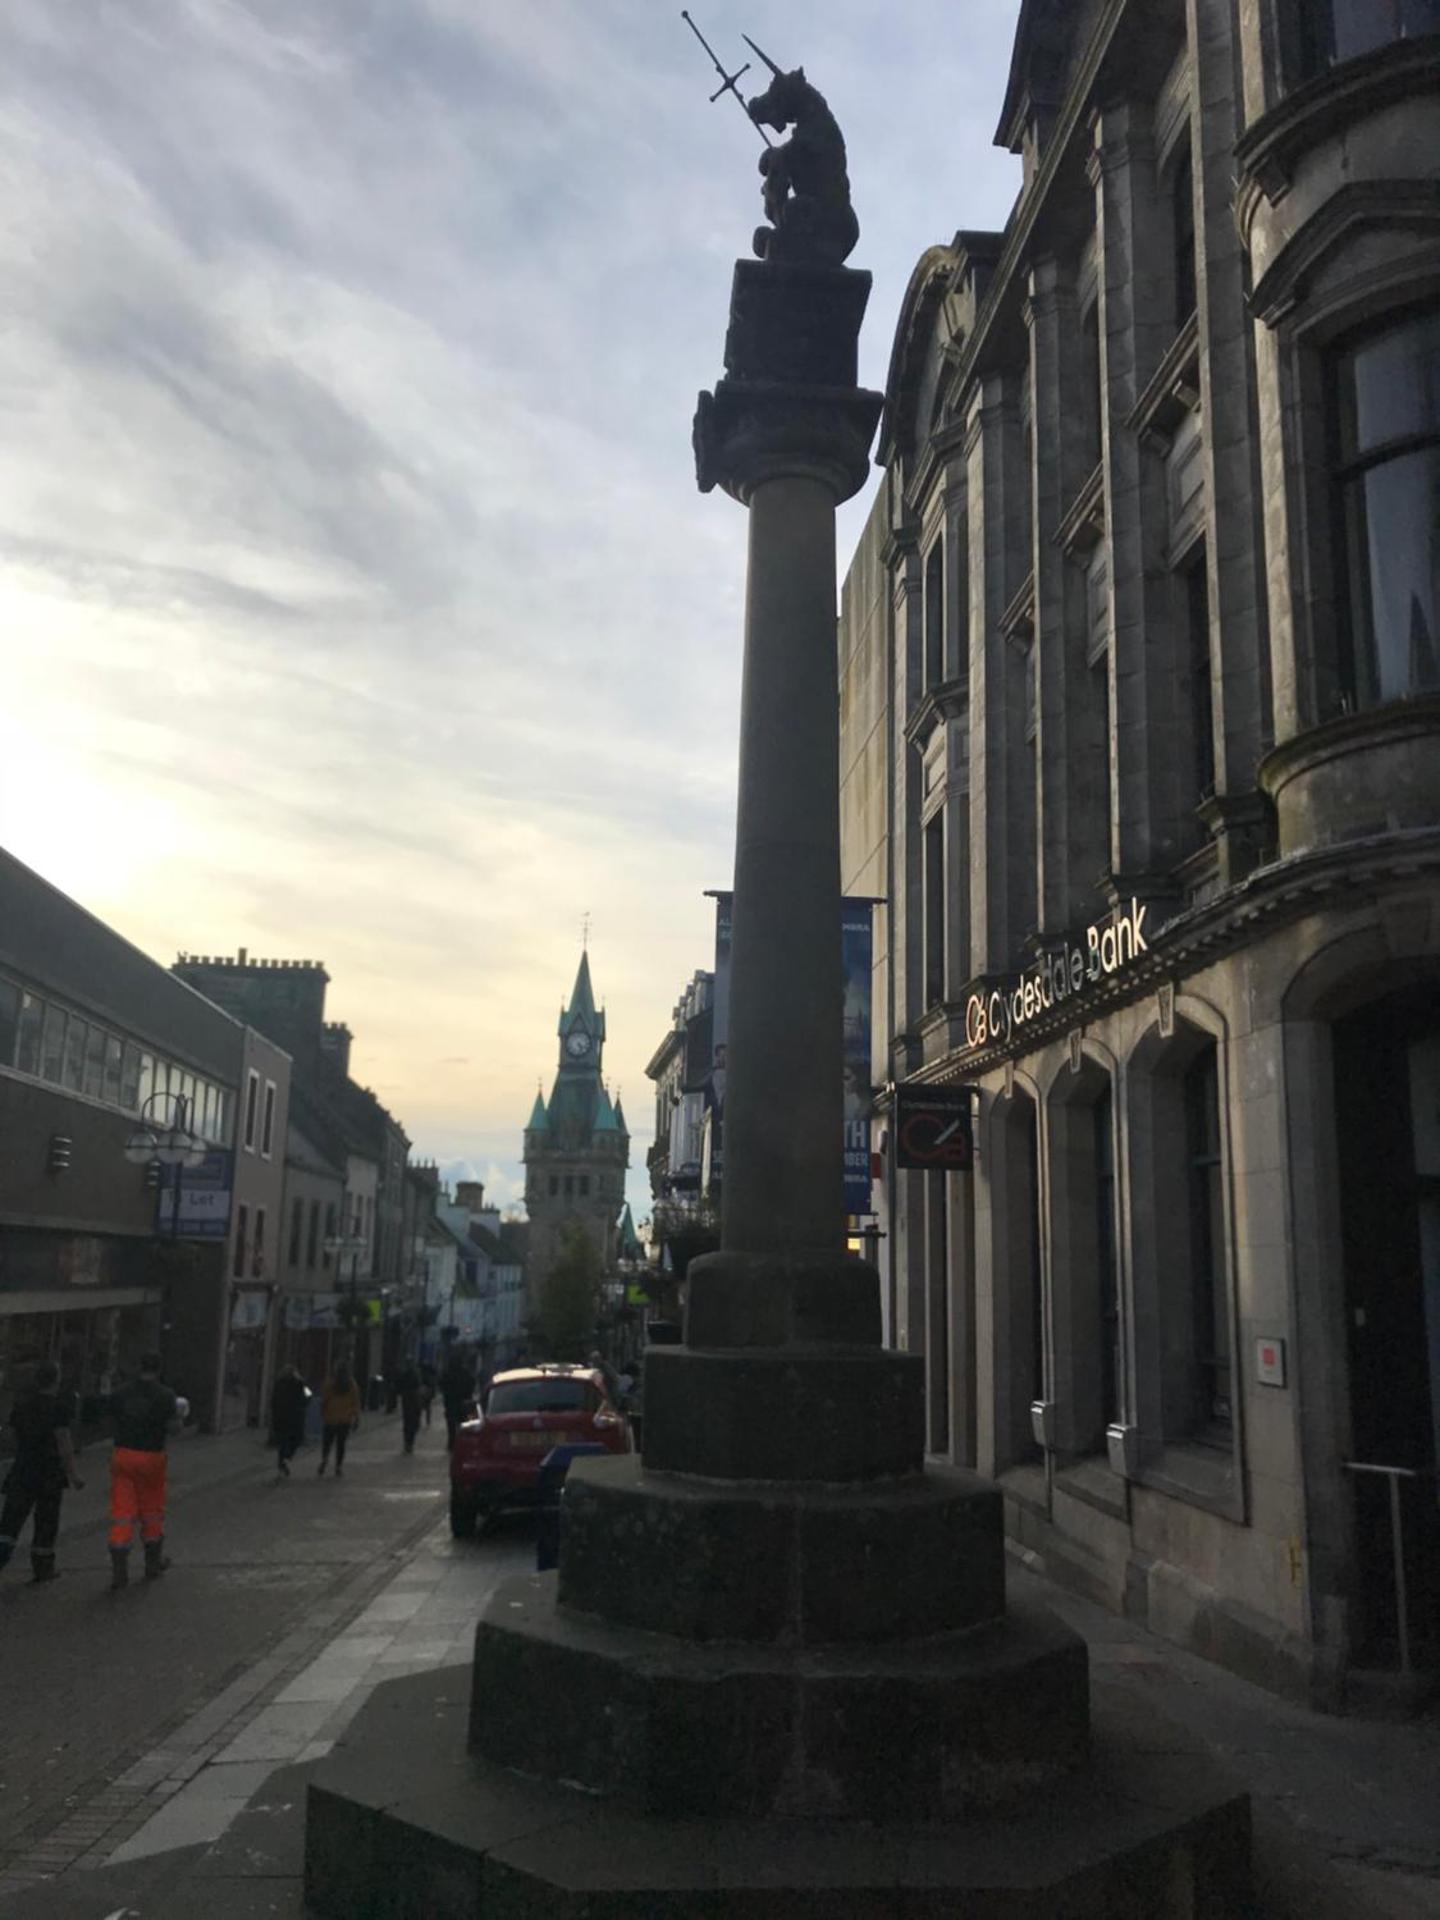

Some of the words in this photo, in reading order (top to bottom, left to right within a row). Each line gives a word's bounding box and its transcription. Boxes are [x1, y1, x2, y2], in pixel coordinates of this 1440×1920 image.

[988, 941, 1084, 1042] Clydesdale
[1087, 896, 1148, 982] Bank
[190, 1191, 214, 1206] Let
